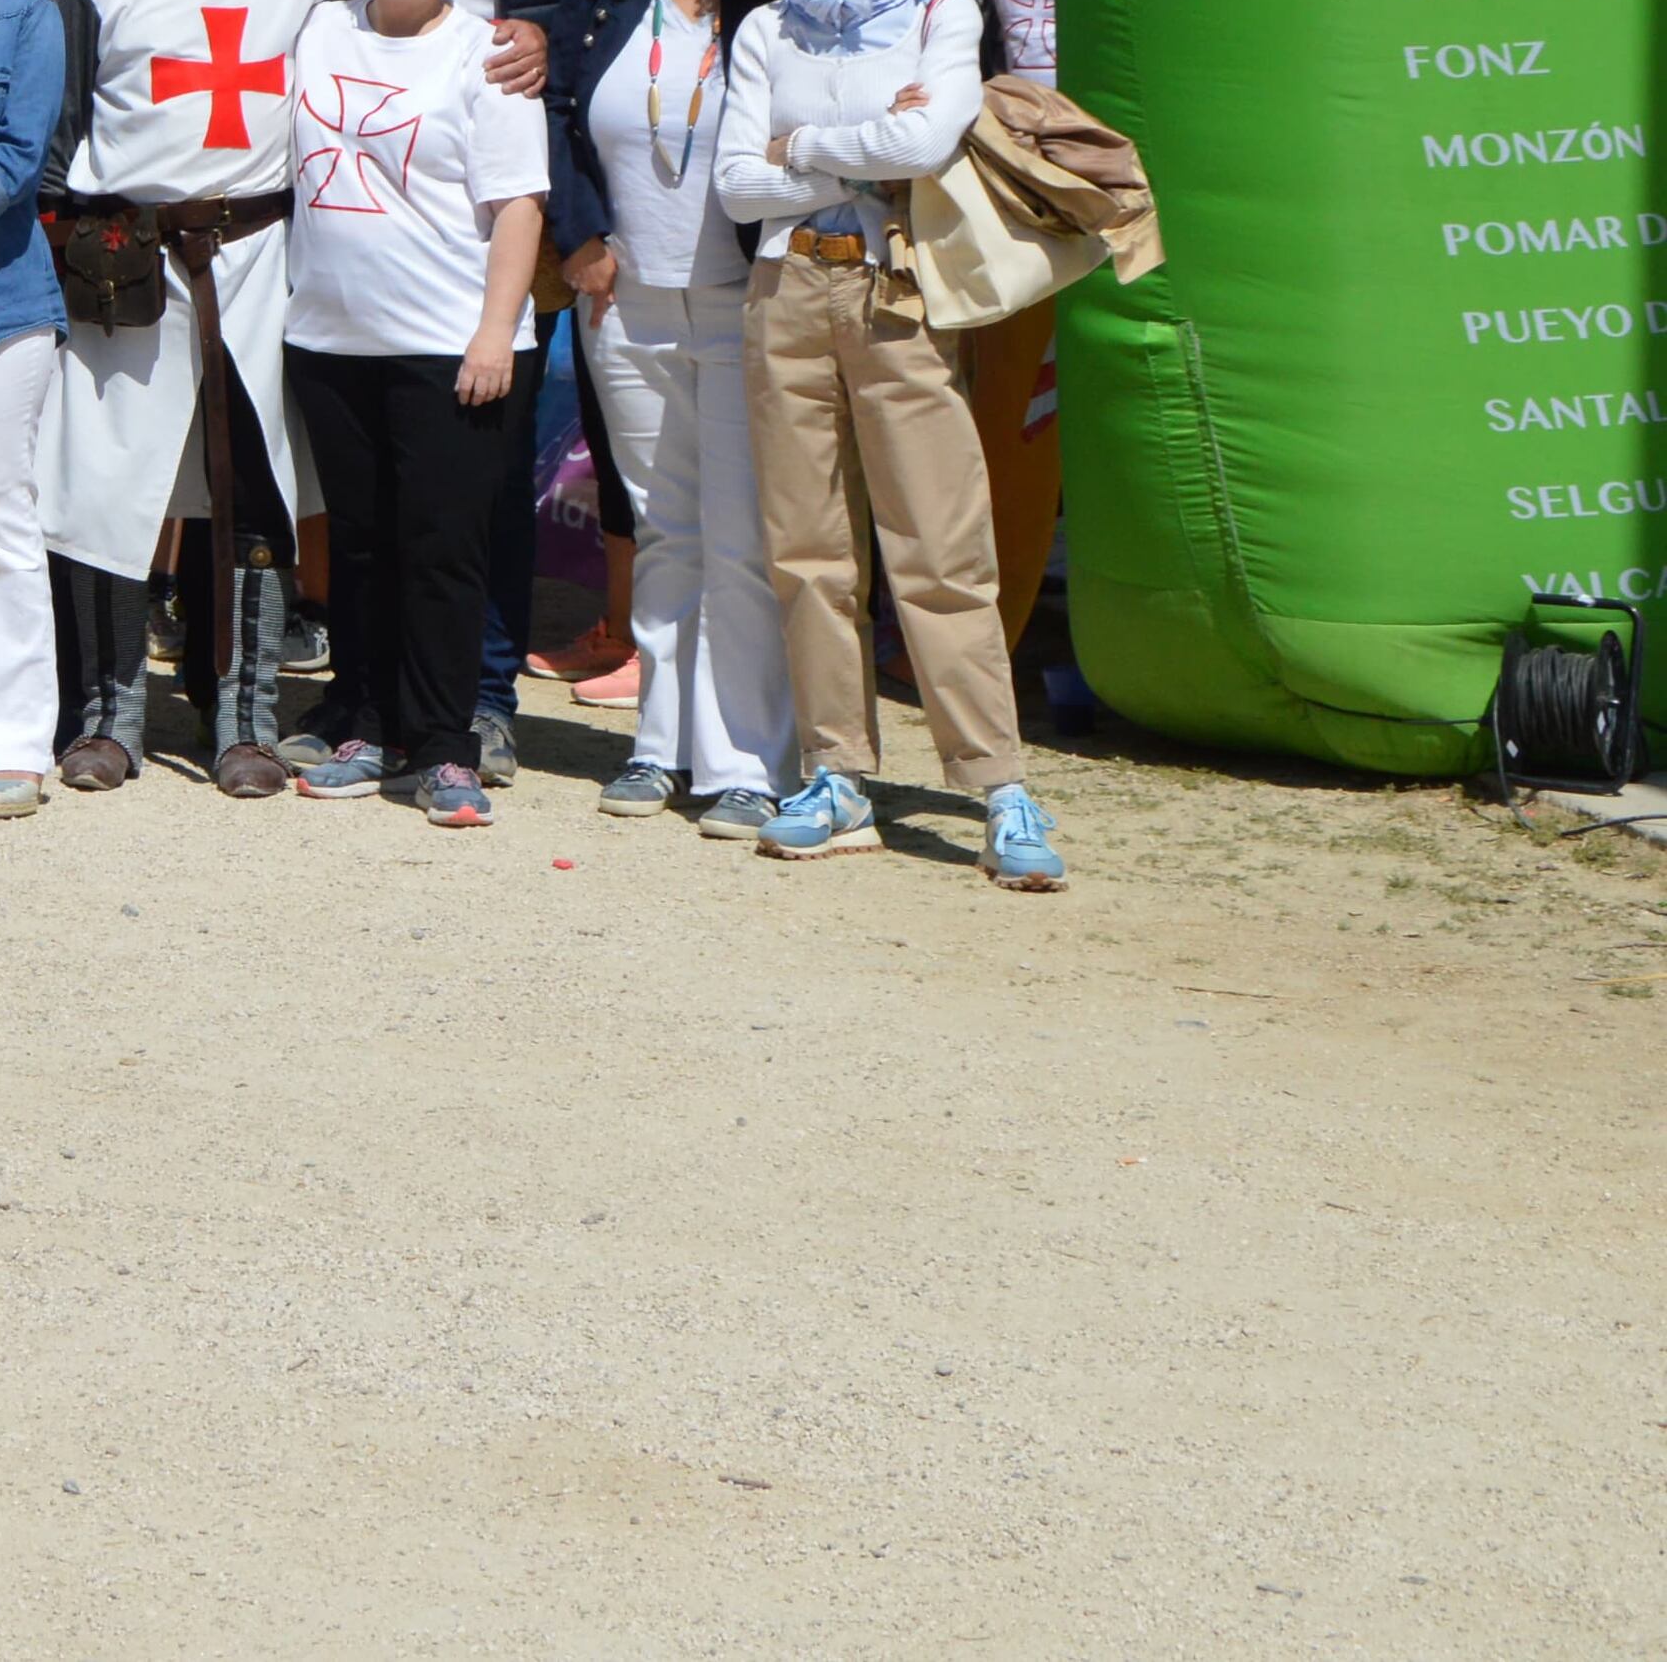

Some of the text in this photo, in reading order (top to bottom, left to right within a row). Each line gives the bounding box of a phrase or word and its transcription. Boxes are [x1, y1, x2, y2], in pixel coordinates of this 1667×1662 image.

[1403, 40, 1551, 79] FONZ
[1422, 121, 1646, 168] MONZÓN
[1441, 215, 1628, 256] POMAR
[1461, 304, 1633, 345] PUEYO
[1521, 565, 1667, 602] VALC
